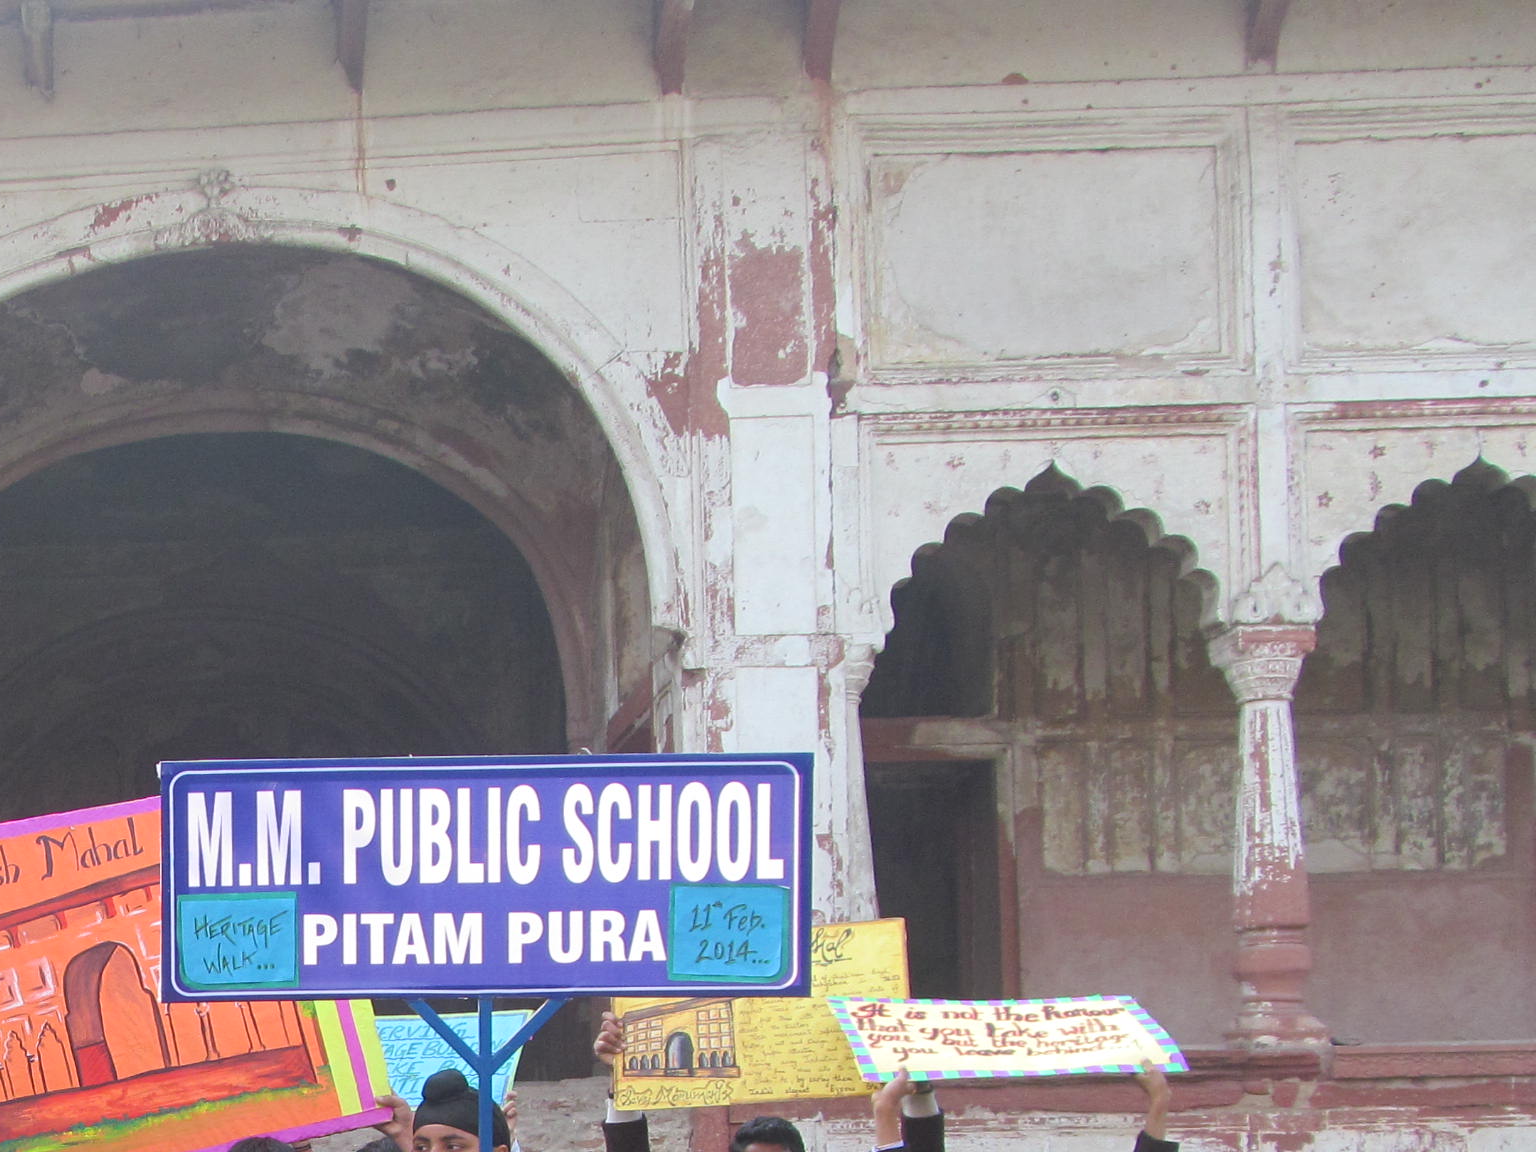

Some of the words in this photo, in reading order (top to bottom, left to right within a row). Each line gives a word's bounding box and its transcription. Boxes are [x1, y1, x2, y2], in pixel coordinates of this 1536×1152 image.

[36, 817, 144, 880] Mahal
[186, 788, 321, 888] M.M.
[342, 784, 541, 886] PUBLIC
[562, 780, 785, 883] SCHOOL
[193, 911, 288, 946] HERITAGE
[303, 911, 482, 966] PITAM
[508, 909, 668, 965] PURA
[904, 1007, 927, 1020] is
[941, 1007, 983, 1020] not
[993, 1006, 1040, 1022] the
[856, 1018, 913, 1033] that
[919, 1027, 974, 1041] you
[985, 1022, 1049, 1039] take
[1058, 1018, 1121, 1036] with
[868, 1033, 915, 1049] you
[941, 1034, 979, 1048] but
[992, 1036, 1027, 1048] the
[892, 1047, 939, 1062] you
